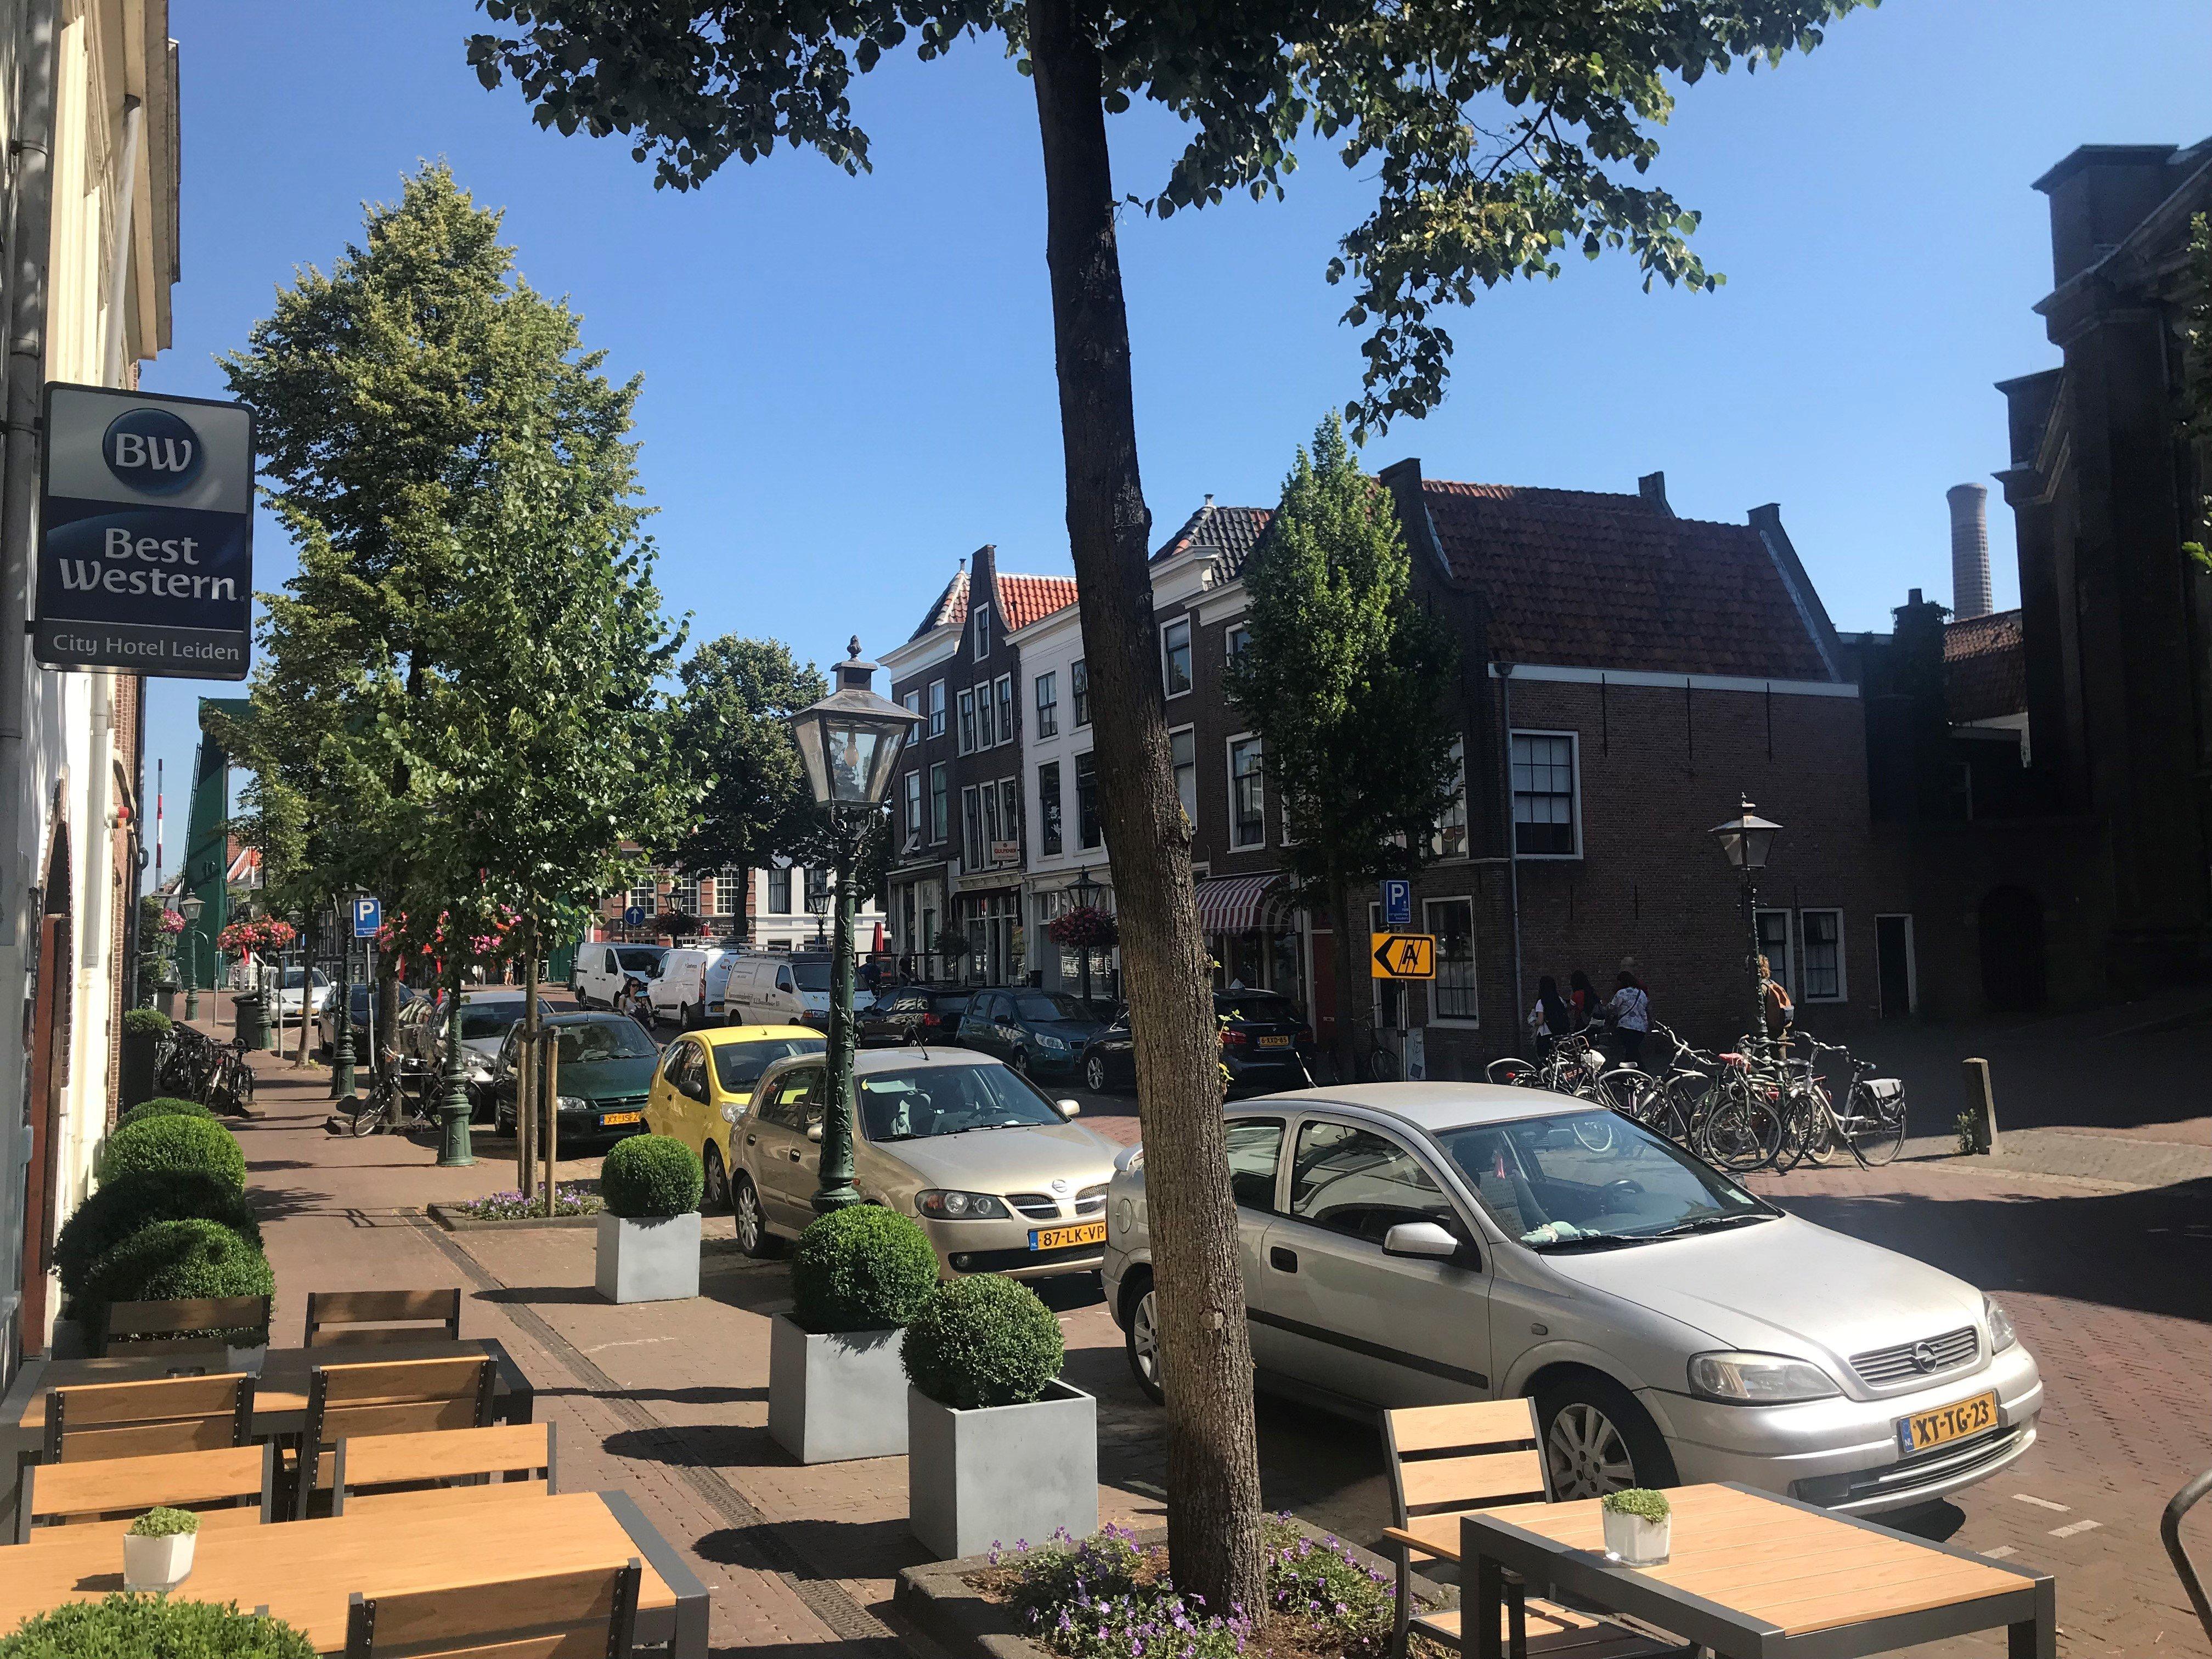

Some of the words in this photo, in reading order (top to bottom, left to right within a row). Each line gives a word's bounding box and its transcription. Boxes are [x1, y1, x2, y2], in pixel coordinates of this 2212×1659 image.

[116, 433, 192, 472] BW
[105, 528, 199, 565] Best
[59, 558, 237, 602] Western
[53, 634, 98, 655] City
[107, 637, 165, 657] Hotel
[173, 641, 240, 661] Leiden
[1391, 884, 1404, 905] P
[359, 901, 375, 921] P
[1402, 944, 1419, 965] A
[1043, 1225, 1104, 1246] 87-LK-VP
[1915, 1400, 1989, 1444] XT-TG-23
